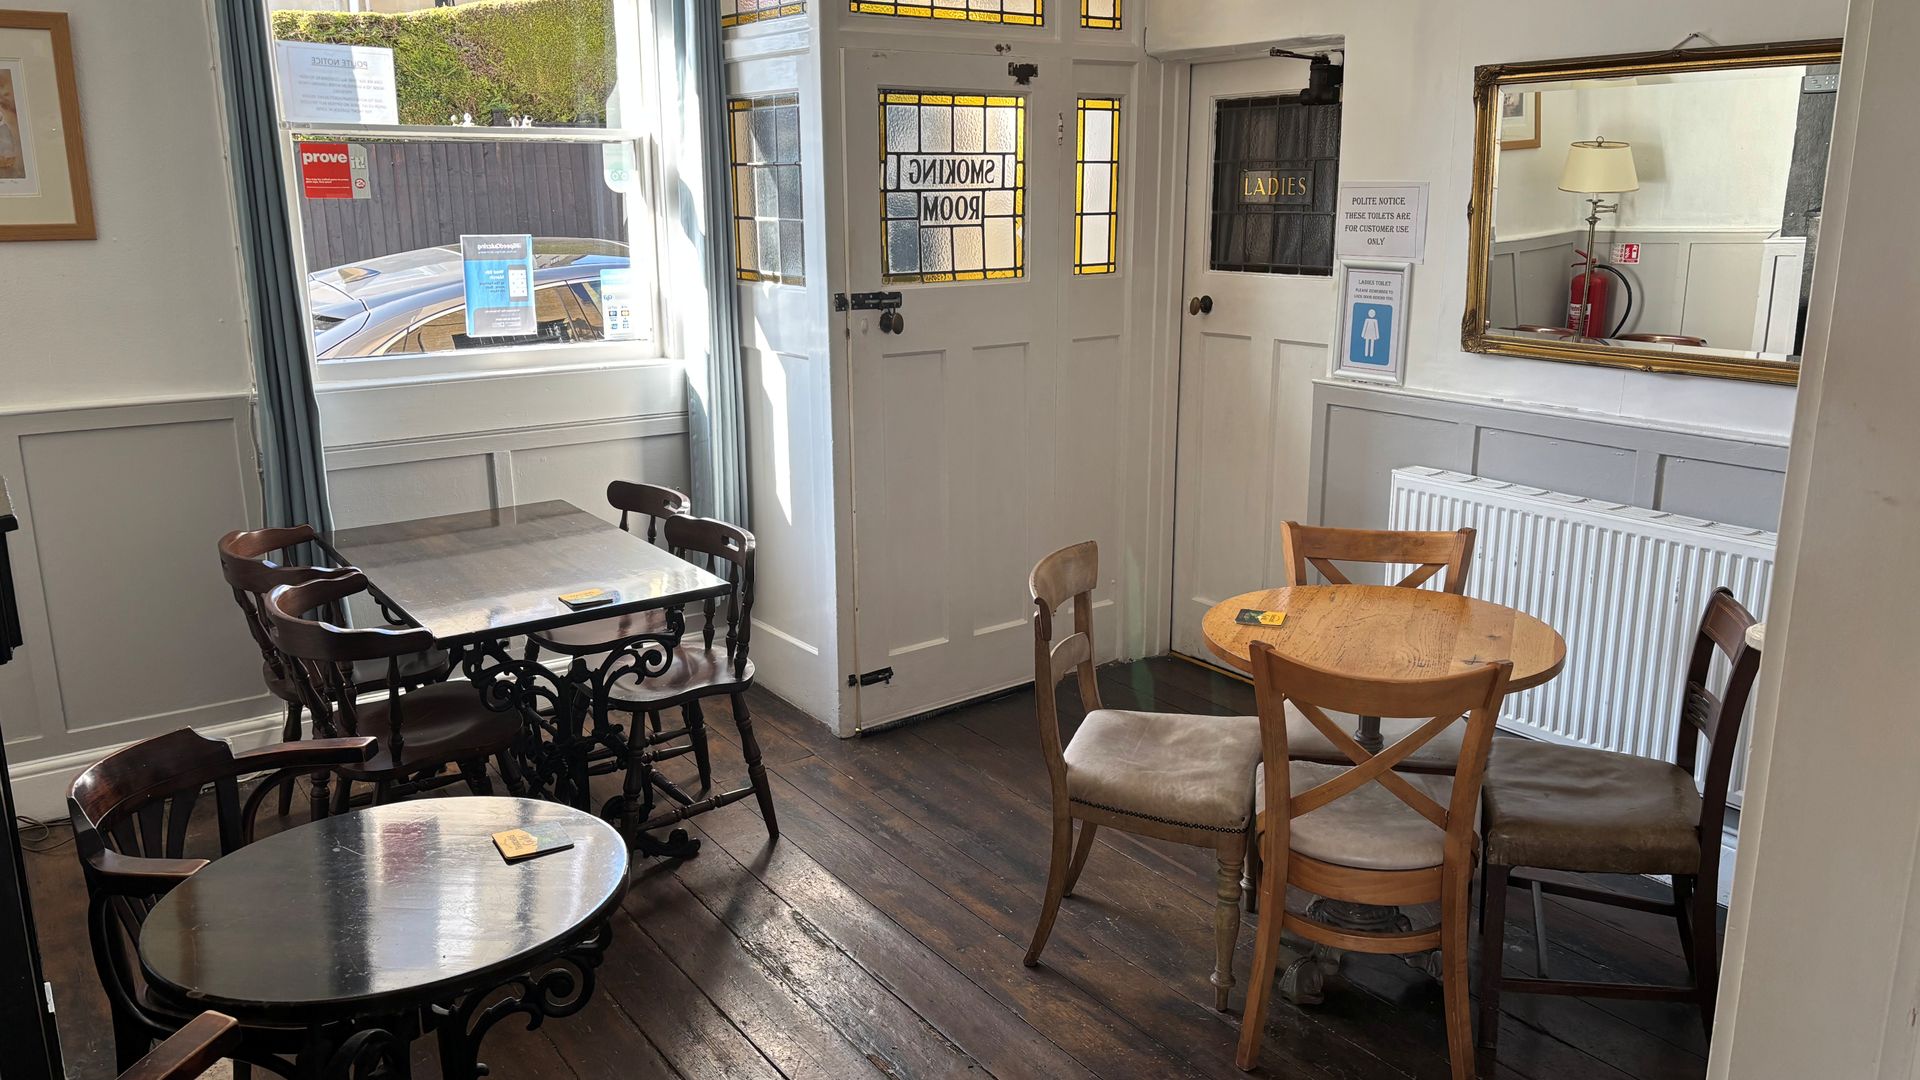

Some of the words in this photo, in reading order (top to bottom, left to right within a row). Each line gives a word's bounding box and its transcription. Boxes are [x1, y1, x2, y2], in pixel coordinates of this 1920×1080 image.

[302, 152, 348, 165] prove
[1243, 176, 1307, 197] LADIES
[1351, 197, 1377, 206] POLITE
[1378, 197, 1406, 206] NOTICE
[1345, 212, 1366, 220] THESE
[1368, 212, 1395, 220] TOILETS
[1396, 212, 1411, 220] ARE
[1344, 224, 1358, 232] FOR
[1359, 224, 1394, 233] CUSTOMER
[1395, 225, 1409, 233] USE
[1367, 237, 1385, 246] ONLY
